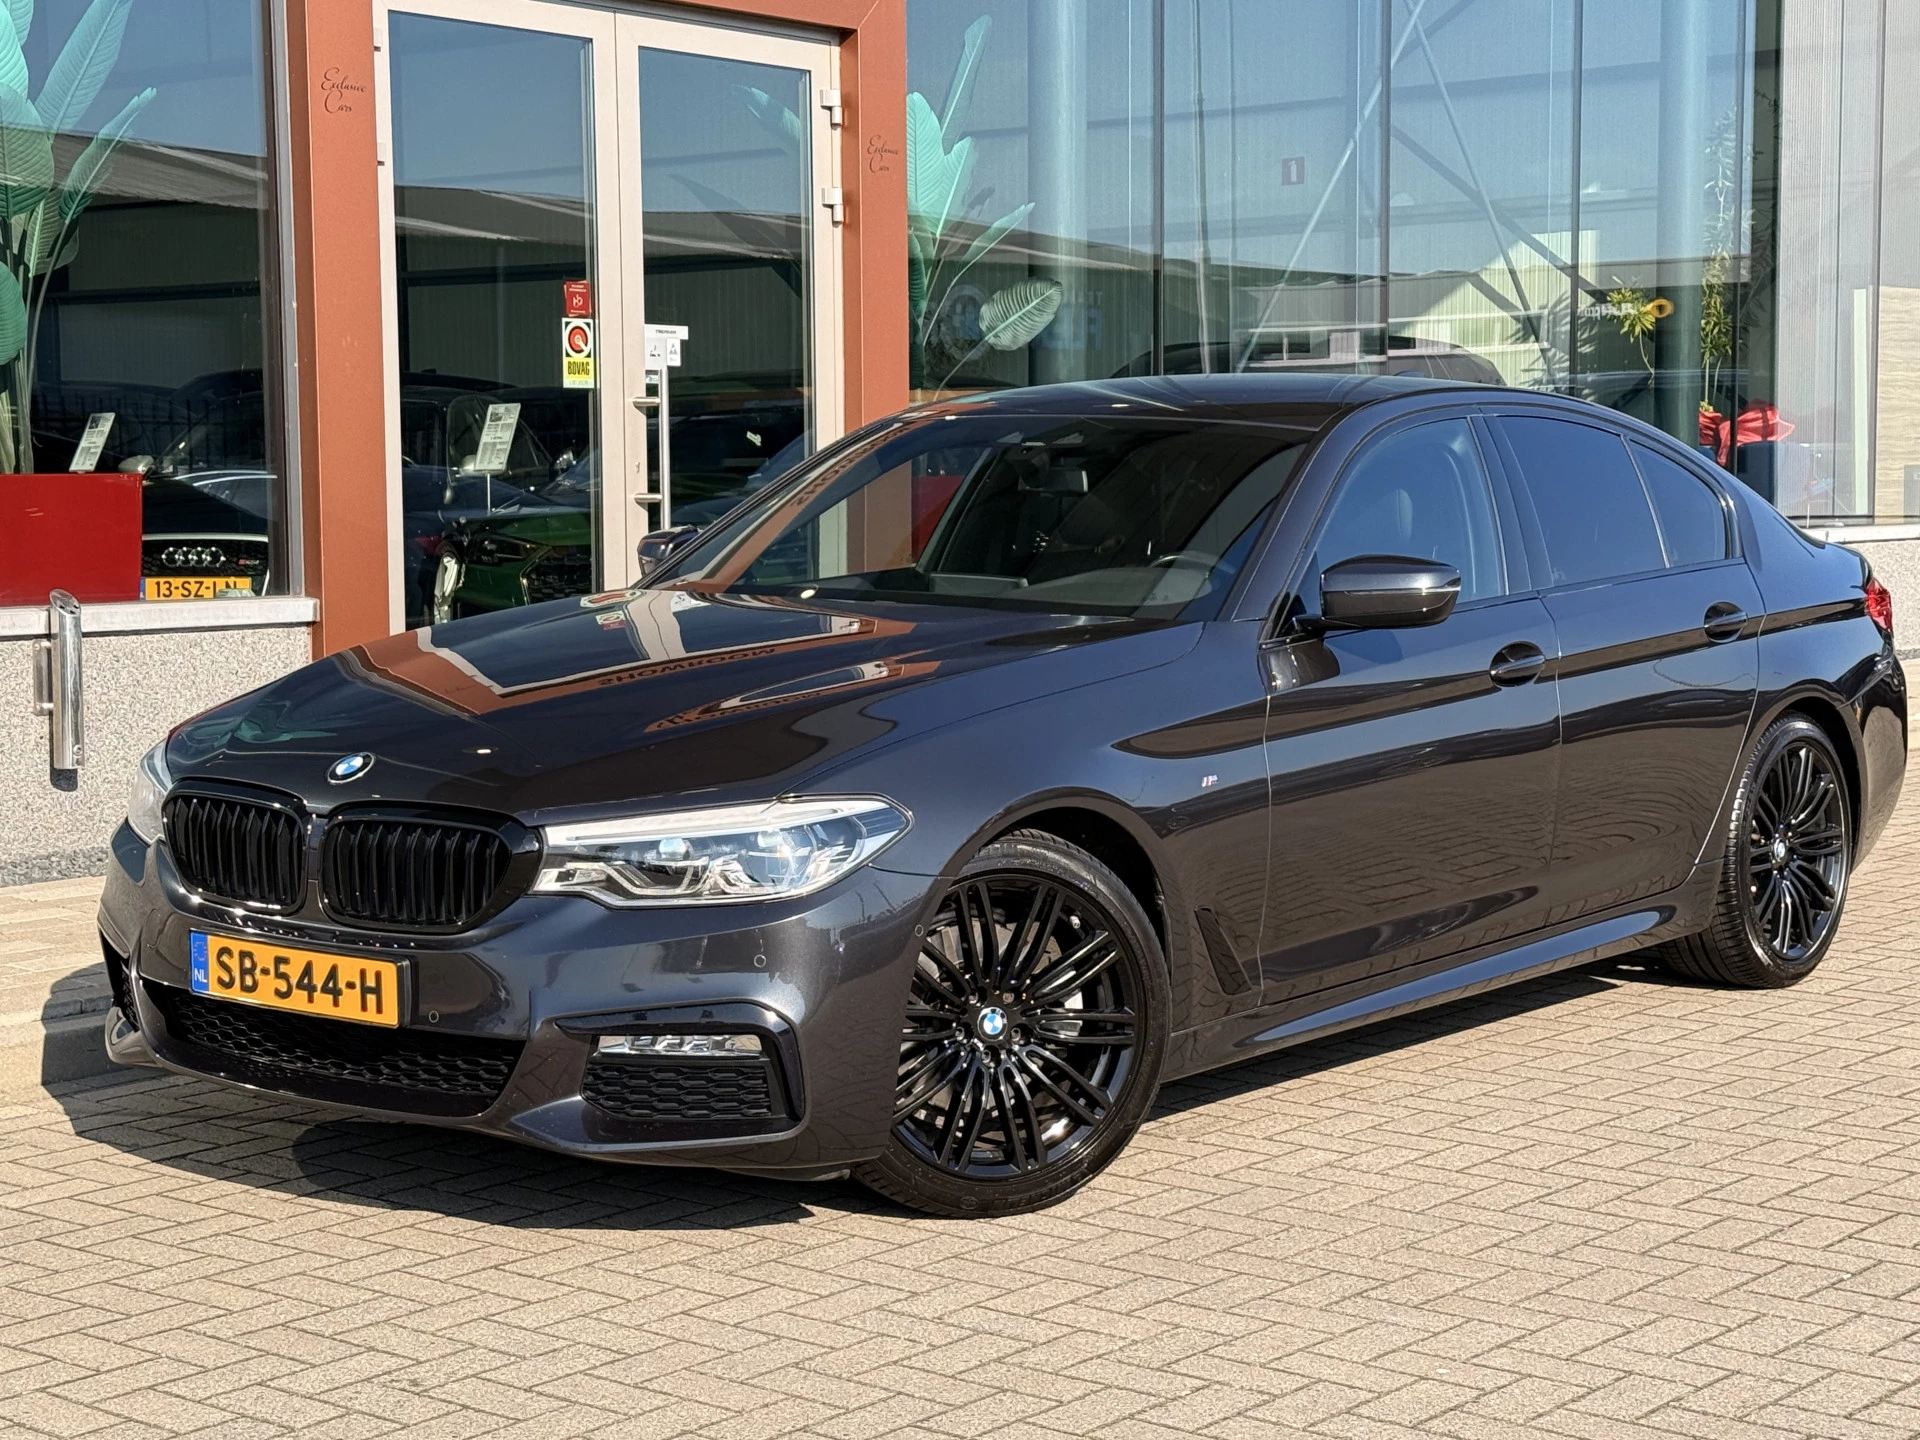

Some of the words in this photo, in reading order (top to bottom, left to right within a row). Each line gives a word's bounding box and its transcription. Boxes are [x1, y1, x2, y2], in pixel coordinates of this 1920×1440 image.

[567, 360, 590, 376] BOVAG
[194, 967, 208, 983] NL
[216, 946, 384, 1015] SB-544-H
